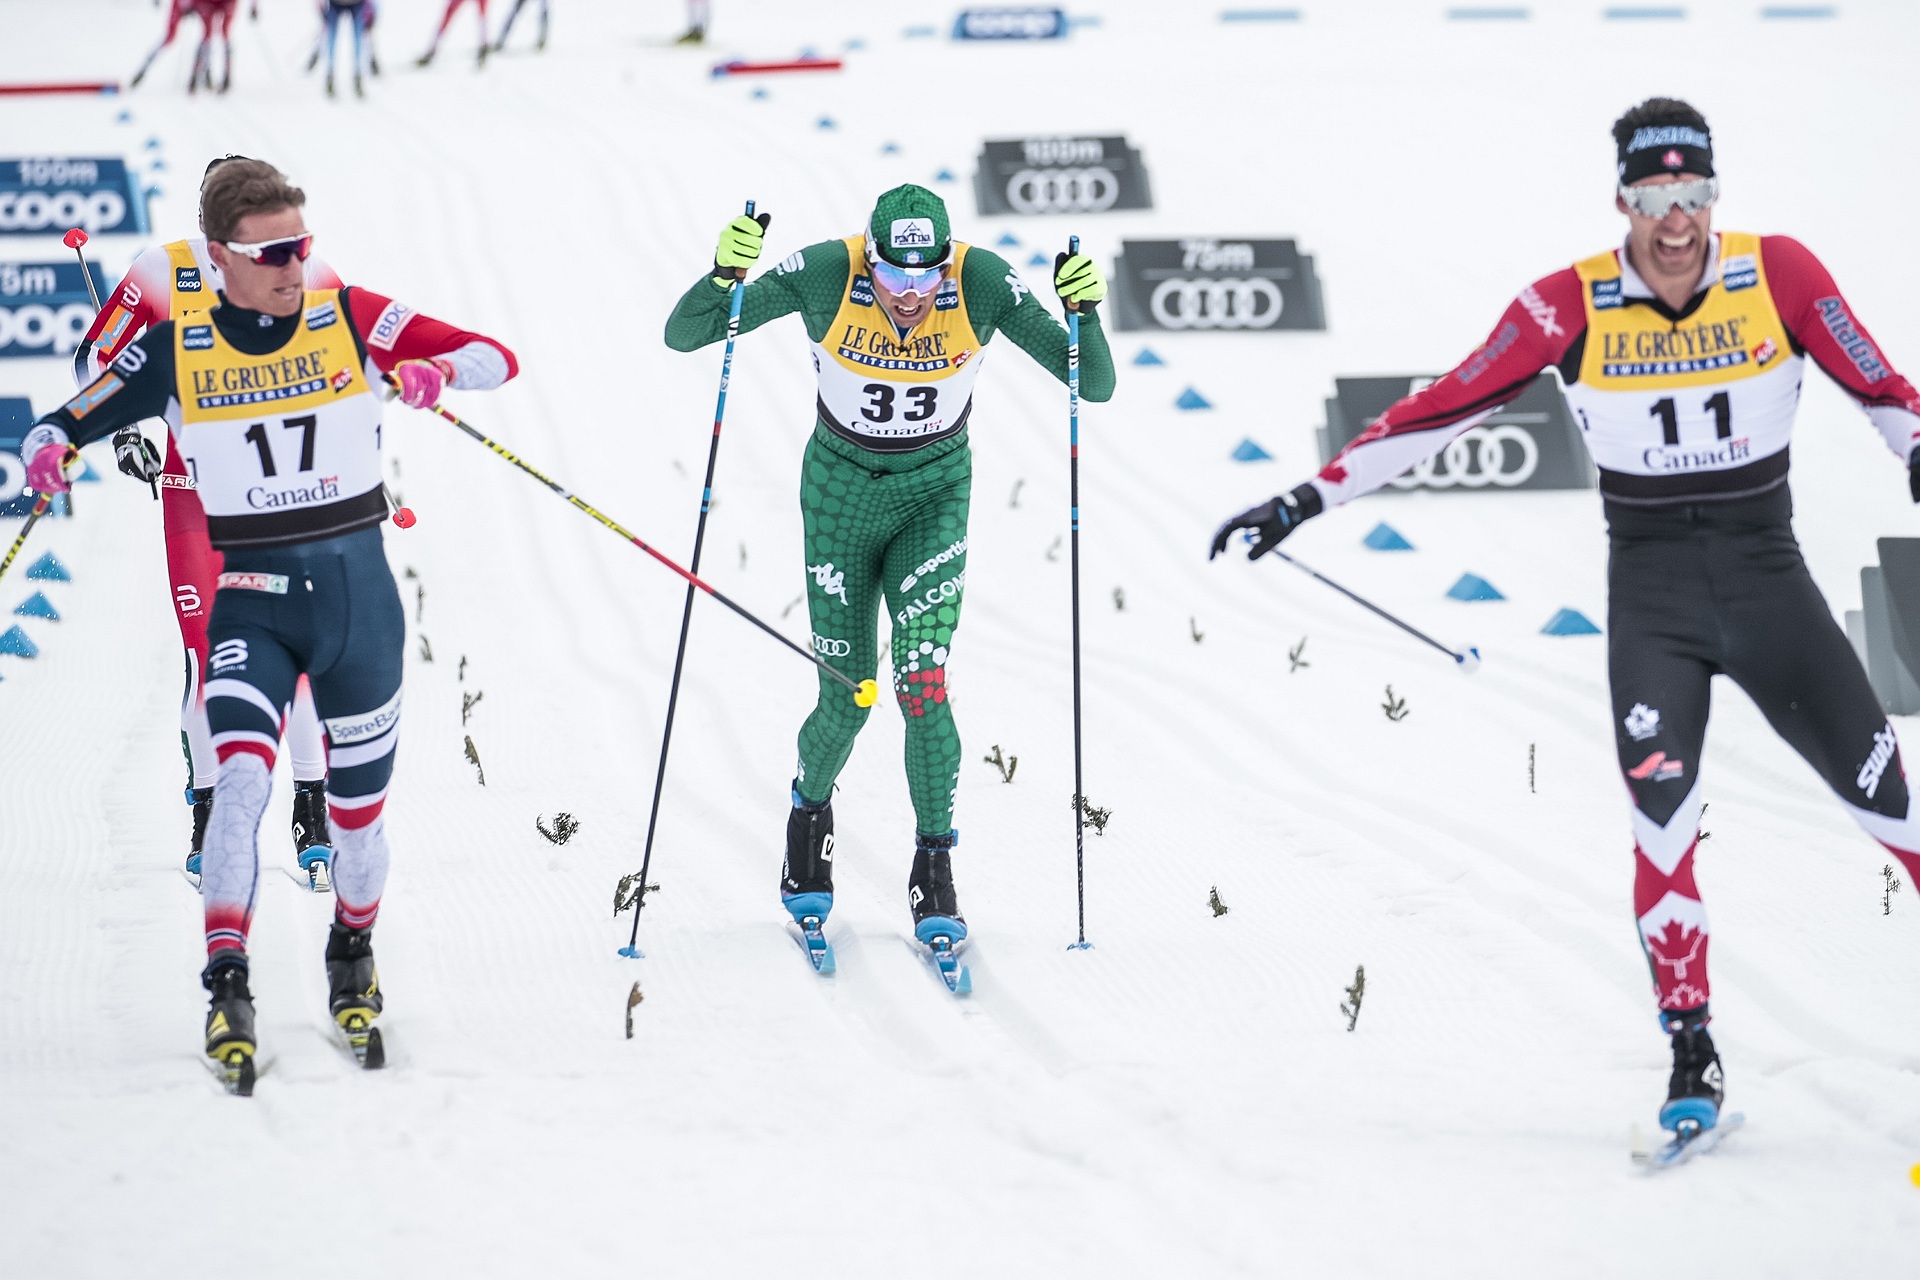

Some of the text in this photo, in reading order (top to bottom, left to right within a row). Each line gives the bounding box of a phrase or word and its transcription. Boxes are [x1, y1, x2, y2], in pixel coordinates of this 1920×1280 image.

[0, 190, 127, 233] coop
[0, 264, 56, 297] 5m
[178, 281, 201, 290] coop
[851, 290, 874, 303] coop
[935, 295, 958, 306] coop
[0, 303, 101, 355] op
[841, 325, 867, 350] LE
[1603, 318, 1745, 360] LE GRUYÈRE
[1814, 295, 1890, 384] AltaGas
[193, 350, 325, 395] LE GRUYÈRE
[842, 349, 945, 372] SWITZERLAND
[1606, 353, 1744, 376] SWITZERLAND
[200, 380, 323, 408] SWITZERLAND
[860, 383, 938, 423] 33
[851, 420, 942, 436] Canada
[1650, 390, 1733, 446] 11
[244, 413, 317, 478] 17
[1643, 438, 1750, 469] Canada
[246, 476, 340, 509] Canada
[897, 569, 966, 626] FALCON
